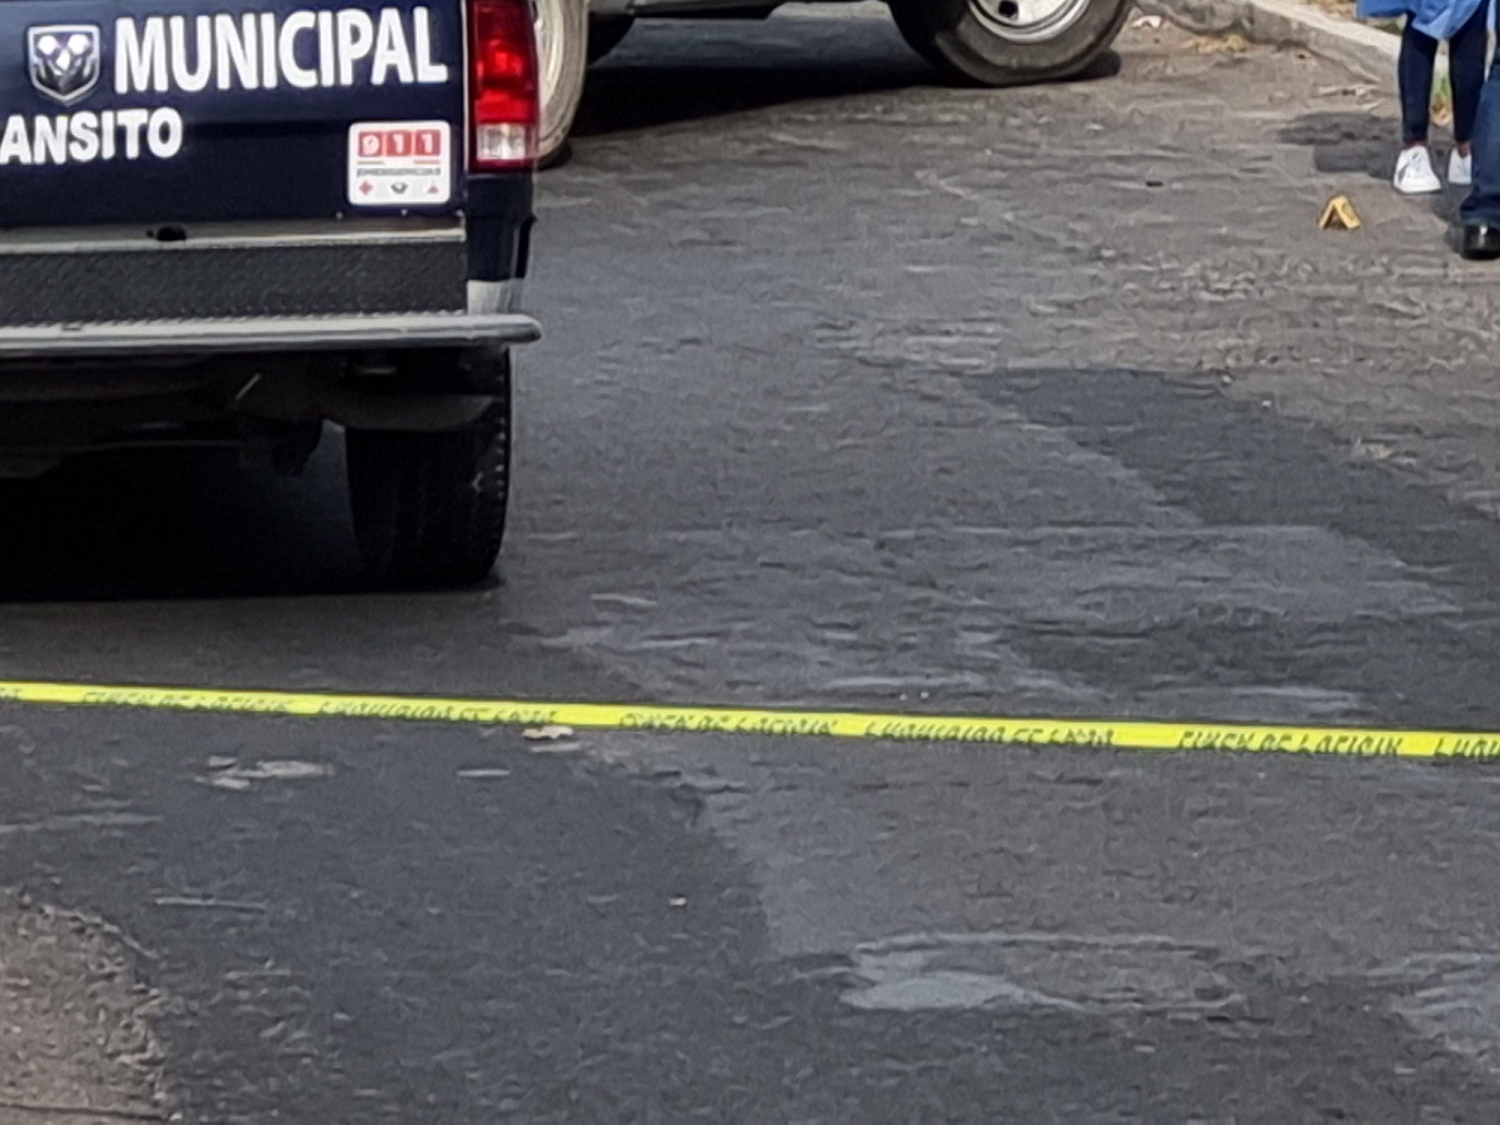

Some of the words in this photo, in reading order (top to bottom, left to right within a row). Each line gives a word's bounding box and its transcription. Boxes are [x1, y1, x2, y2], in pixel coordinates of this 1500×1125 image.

[114, 6, 449, 95] MUNICIPAL
[0, 106, 183, 165] ANSITO
[361, 132, 434, 155] 911
